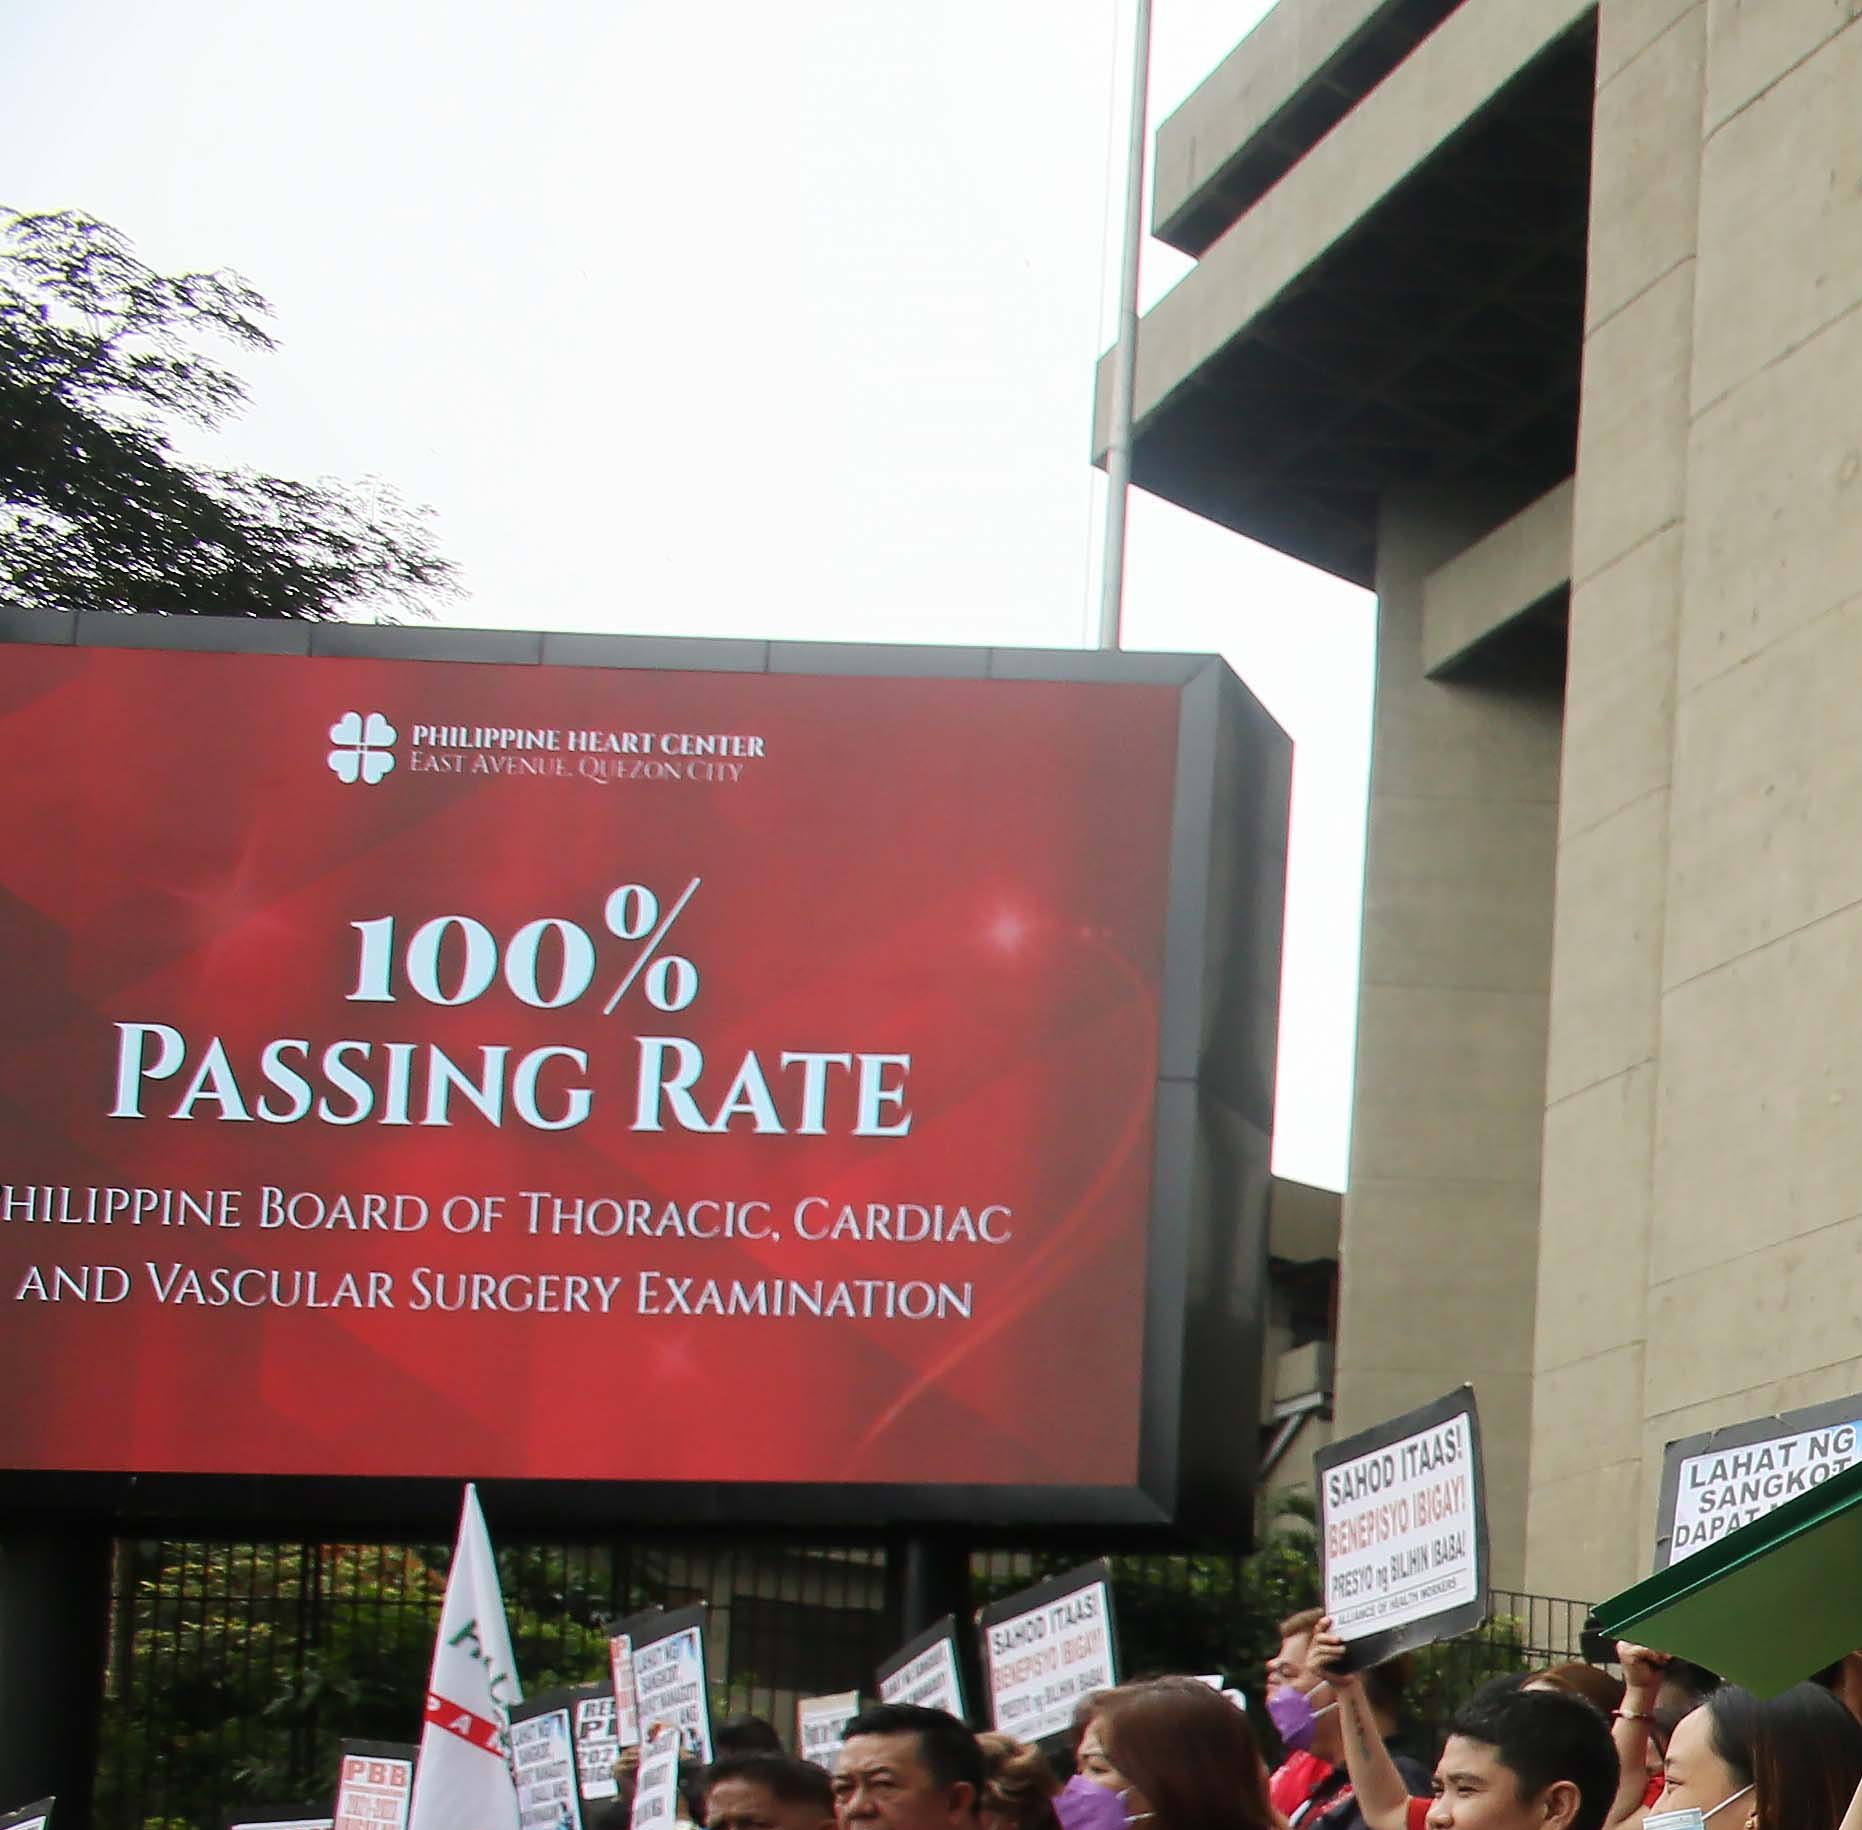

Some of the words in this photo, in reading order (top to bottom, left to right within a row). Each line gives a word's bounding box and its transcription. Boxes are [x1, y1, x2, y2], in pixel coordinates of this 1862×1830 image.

[410, 750, 467, 775] EAST
[686, 760, 745, 783] CITY
[412, 724, 560, 751] PHILIPPINE
[568, 731, 653, 754] HEART
[661, 733, 765, 758] CENTER
[345, 876, 701, 1015] 100%
[106, 1021, 595, 1132] PASSING
[629, 1037, 913, 1139] RATE
[0, 1182, 242, 1230] HILIPPINE
[258, 1186, 432, 1234] BOARD
[441, 1192, 505, 1237] OF
[519, 1189, 780, 1243] THORACIC,
[792, 1197, 1013, 1247] CARDIAC
[15, 1265, 131, 1304] AND
[144, 1260, 395, 1311] VASCULAR
[408, 1265, 622, 1318] SURGERY
[636, 1270, 974, 1324] EXAMINATION
[1329, 1454, 1395, 1508] SAHOD
[1402, 1425, 1463, 1480] ITAAS!
[1691, 1443, 1797, 1489] LAHAT
[1808, 1427, 1857, 1463] NG
[1327, 1499, 1409, 1558] BENEPISYO
[1412, 1475, 1466, 1529] IBIGAY!
[1331, 1564, 1373, 1601] PRESYO
[1376, 1567, 1389, 1592] ng
[1390, 1544, 1431, 1583] BILIHIN
